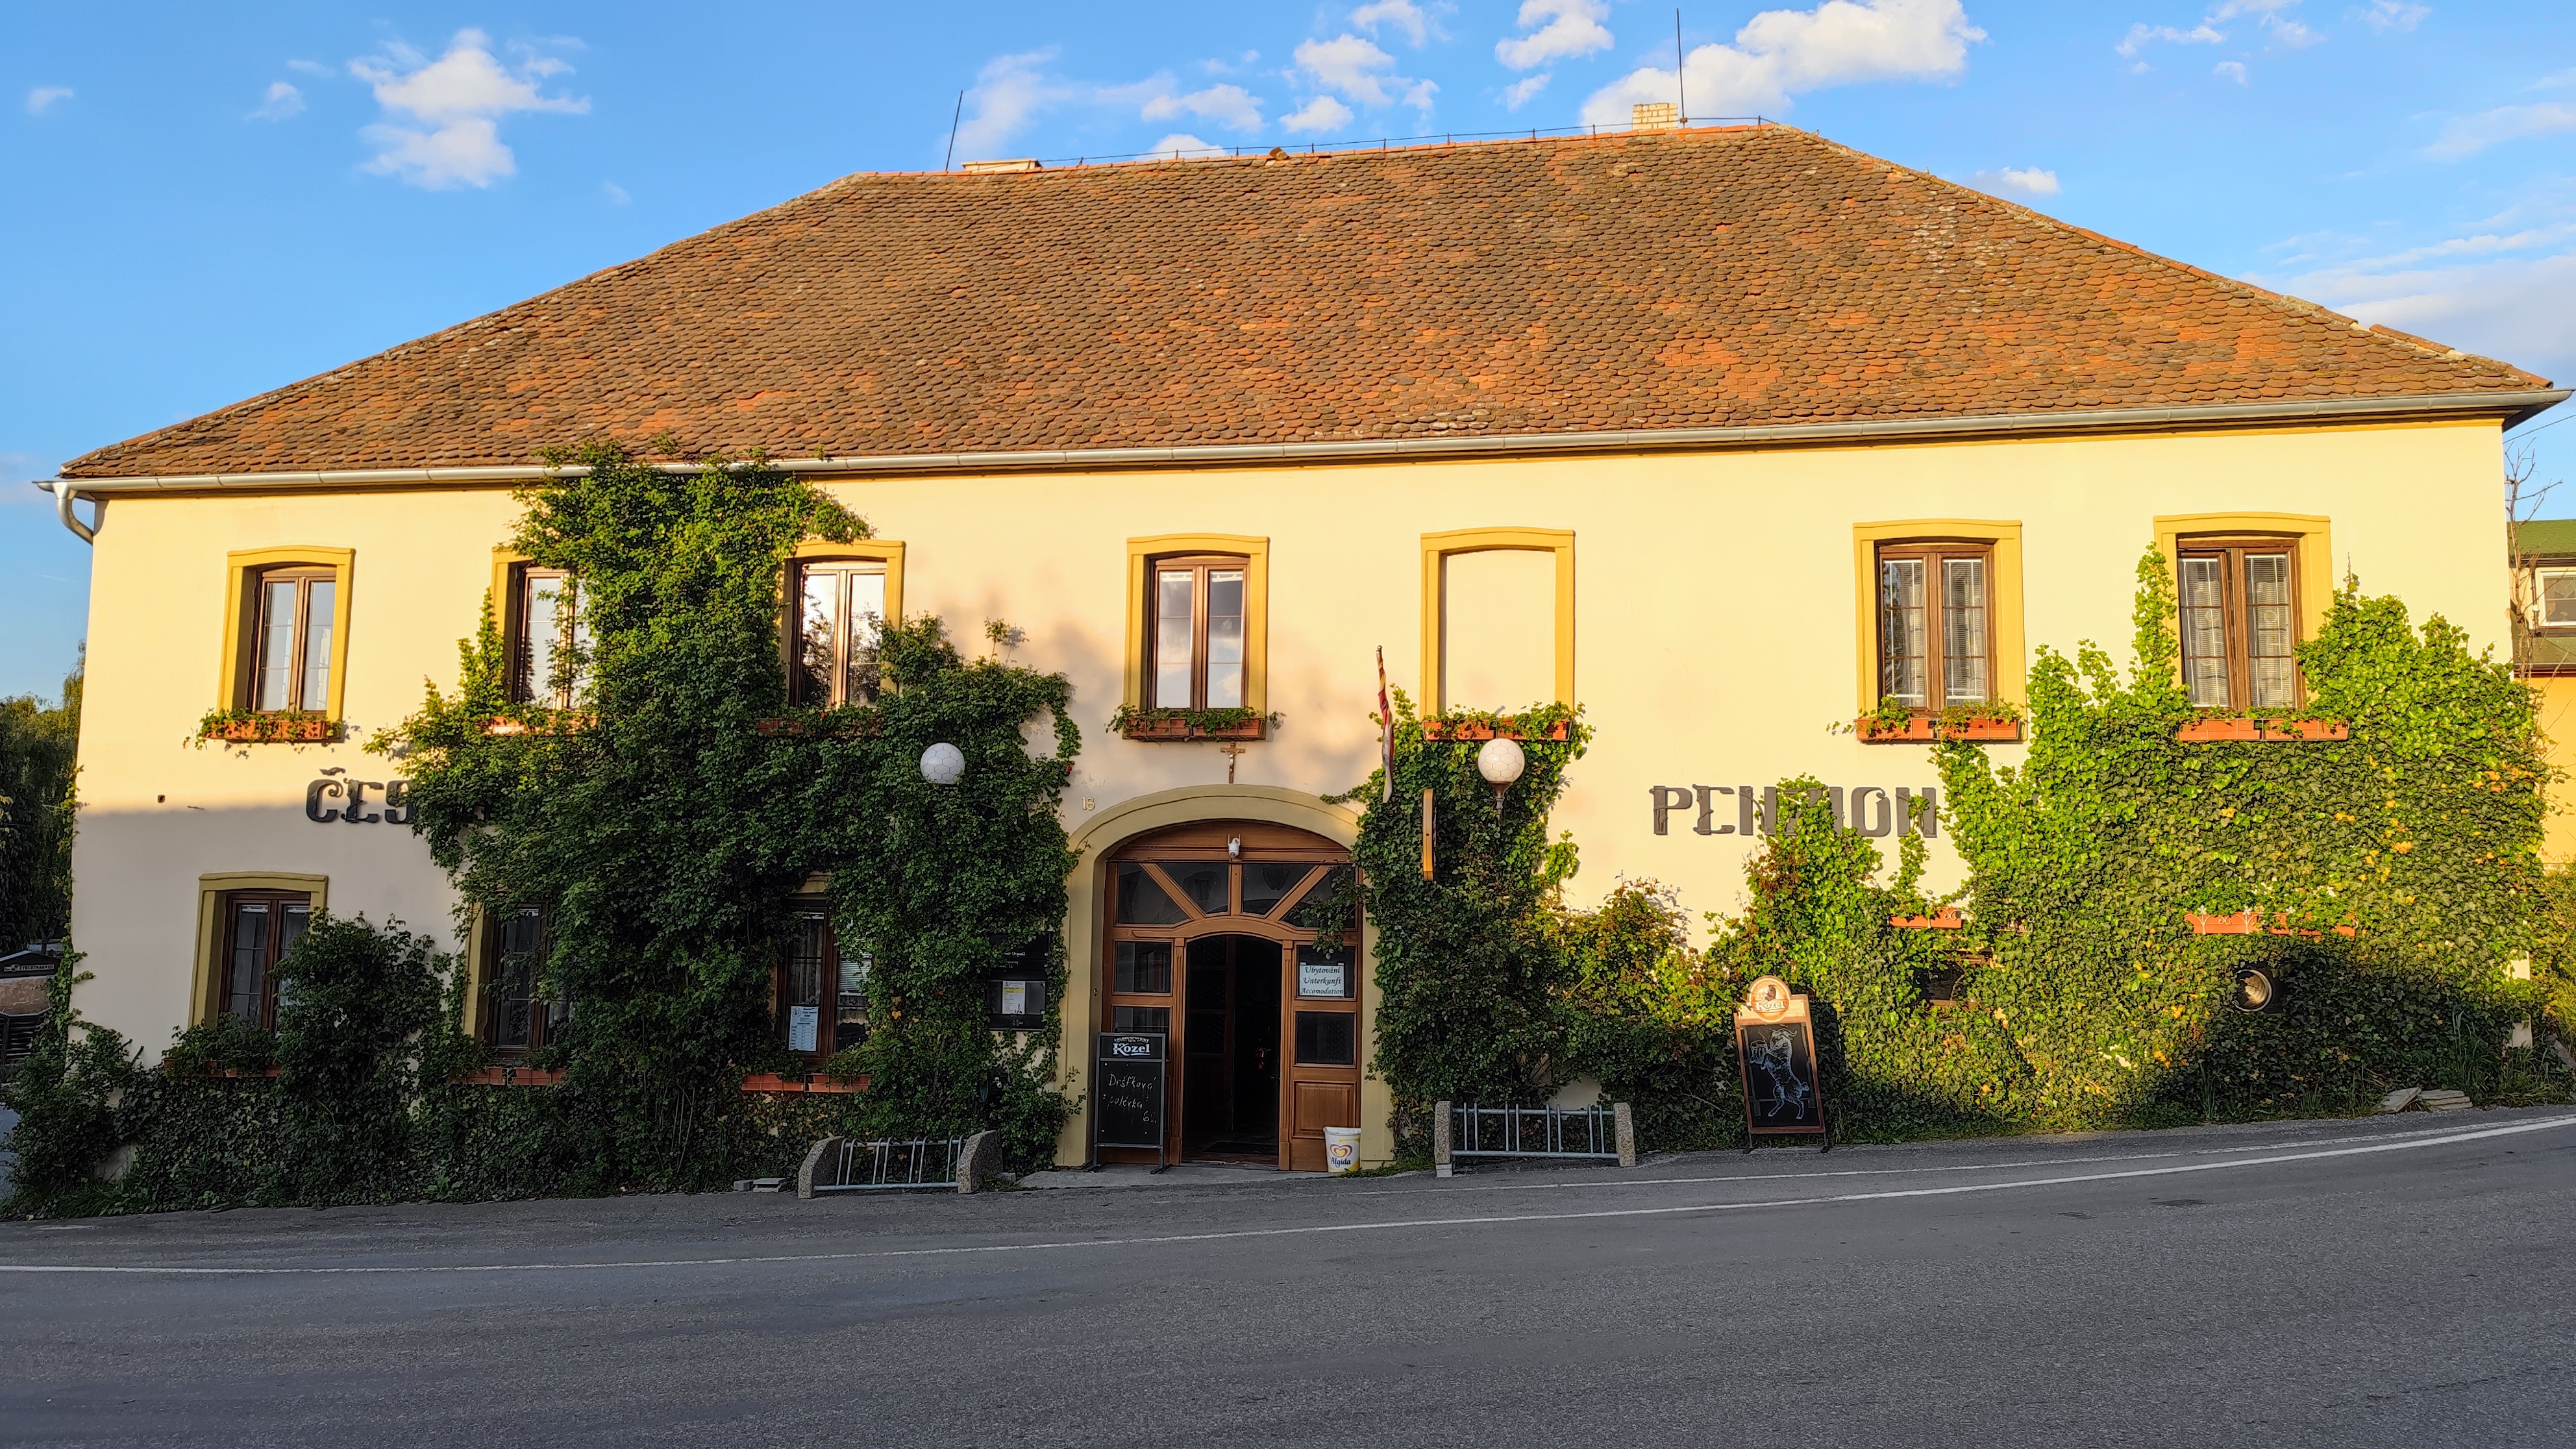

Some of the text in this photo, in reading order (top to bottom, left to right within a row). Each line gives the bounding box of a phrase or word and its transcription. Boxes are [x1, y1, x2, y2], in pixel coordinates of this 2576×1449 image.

[1304, 966, 1341, 976] Ubytování
[1302, 976, 1342, 986] Unterkunft
[1755, 1000, 1786, 1011] Kozel
[1112, 1043, 1151, 1056] Kozel
[1330, 1157, 1351, 1168] Algida
